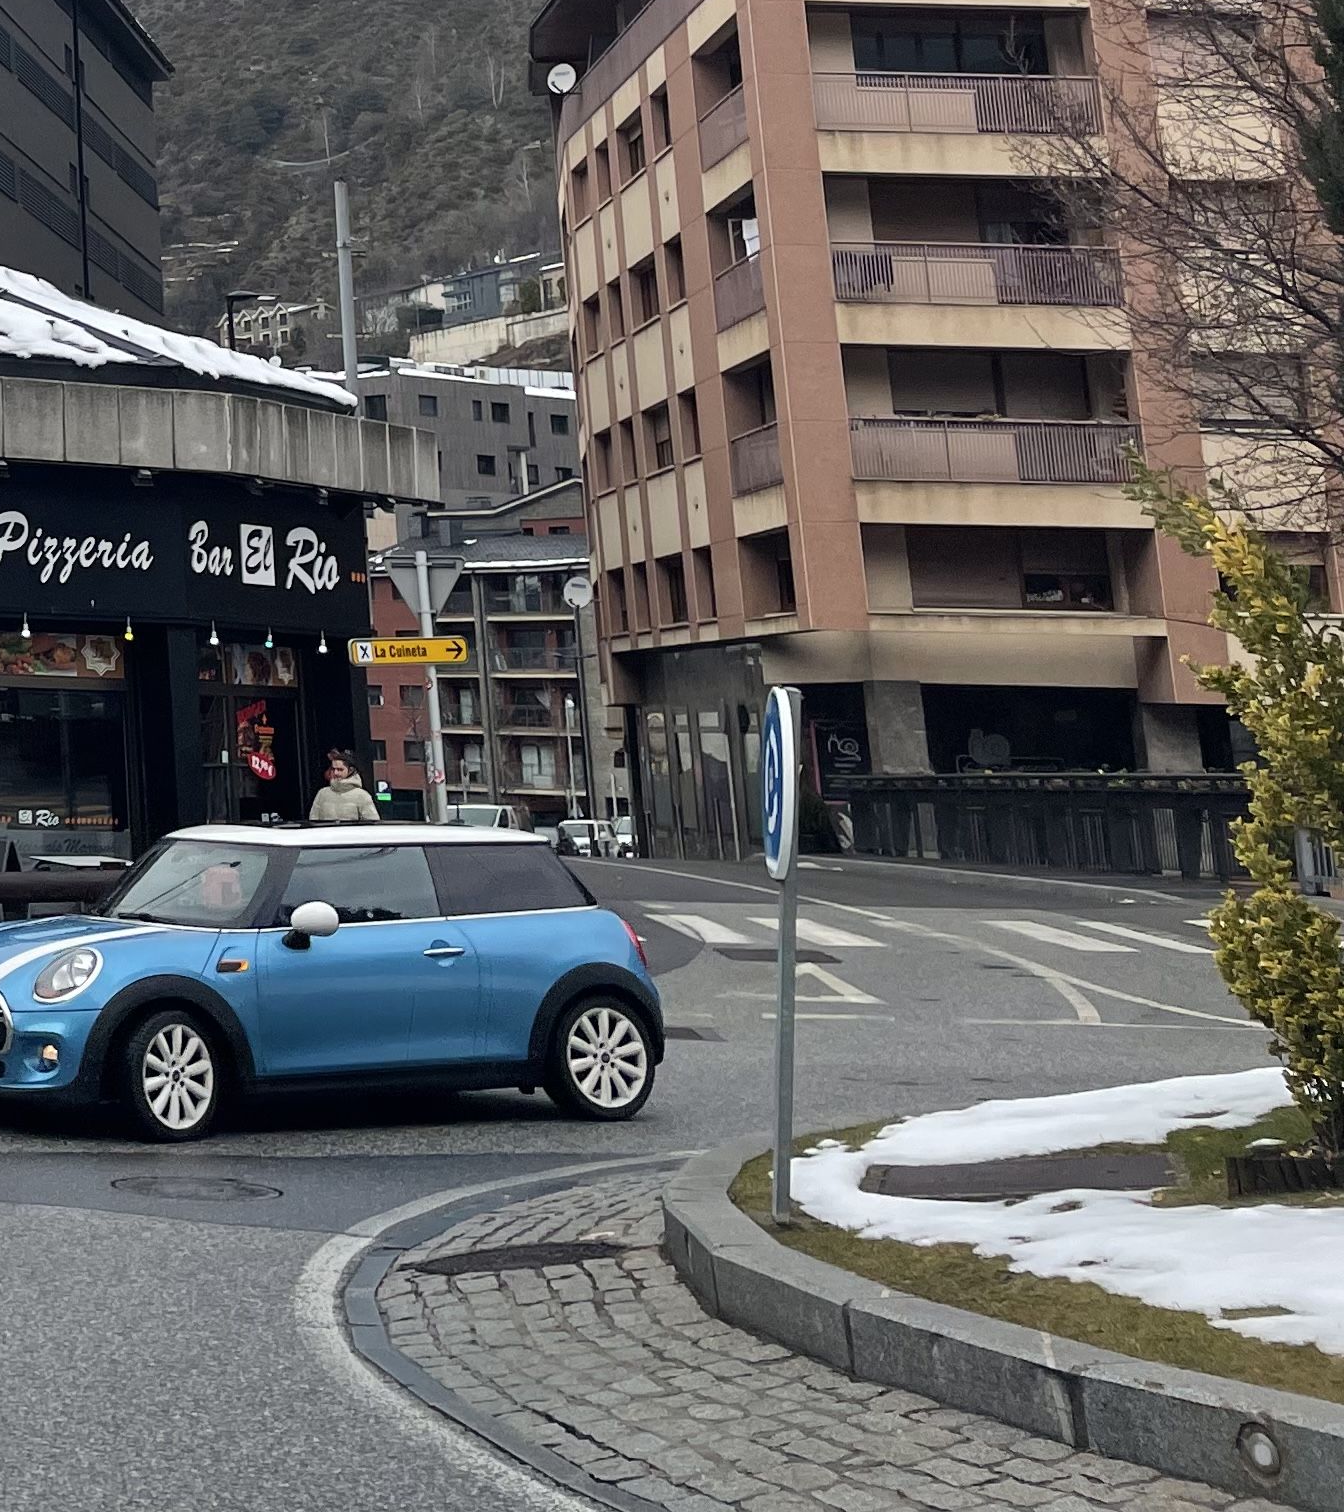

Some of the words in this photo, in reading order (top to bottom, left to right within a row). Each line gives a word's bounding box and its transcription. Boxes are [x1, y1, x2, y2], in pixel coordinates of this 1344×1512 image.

[188, 520, 234, 576] Bar
[244, 528, 273, 575] El
[285, 526, 340, 594] Rio
[374, 645, 386, 658] La
[389, 644, 427, 658] Cuineta
[377, 781, 389, 792] P
[35, 809, 60, 827] Rio
